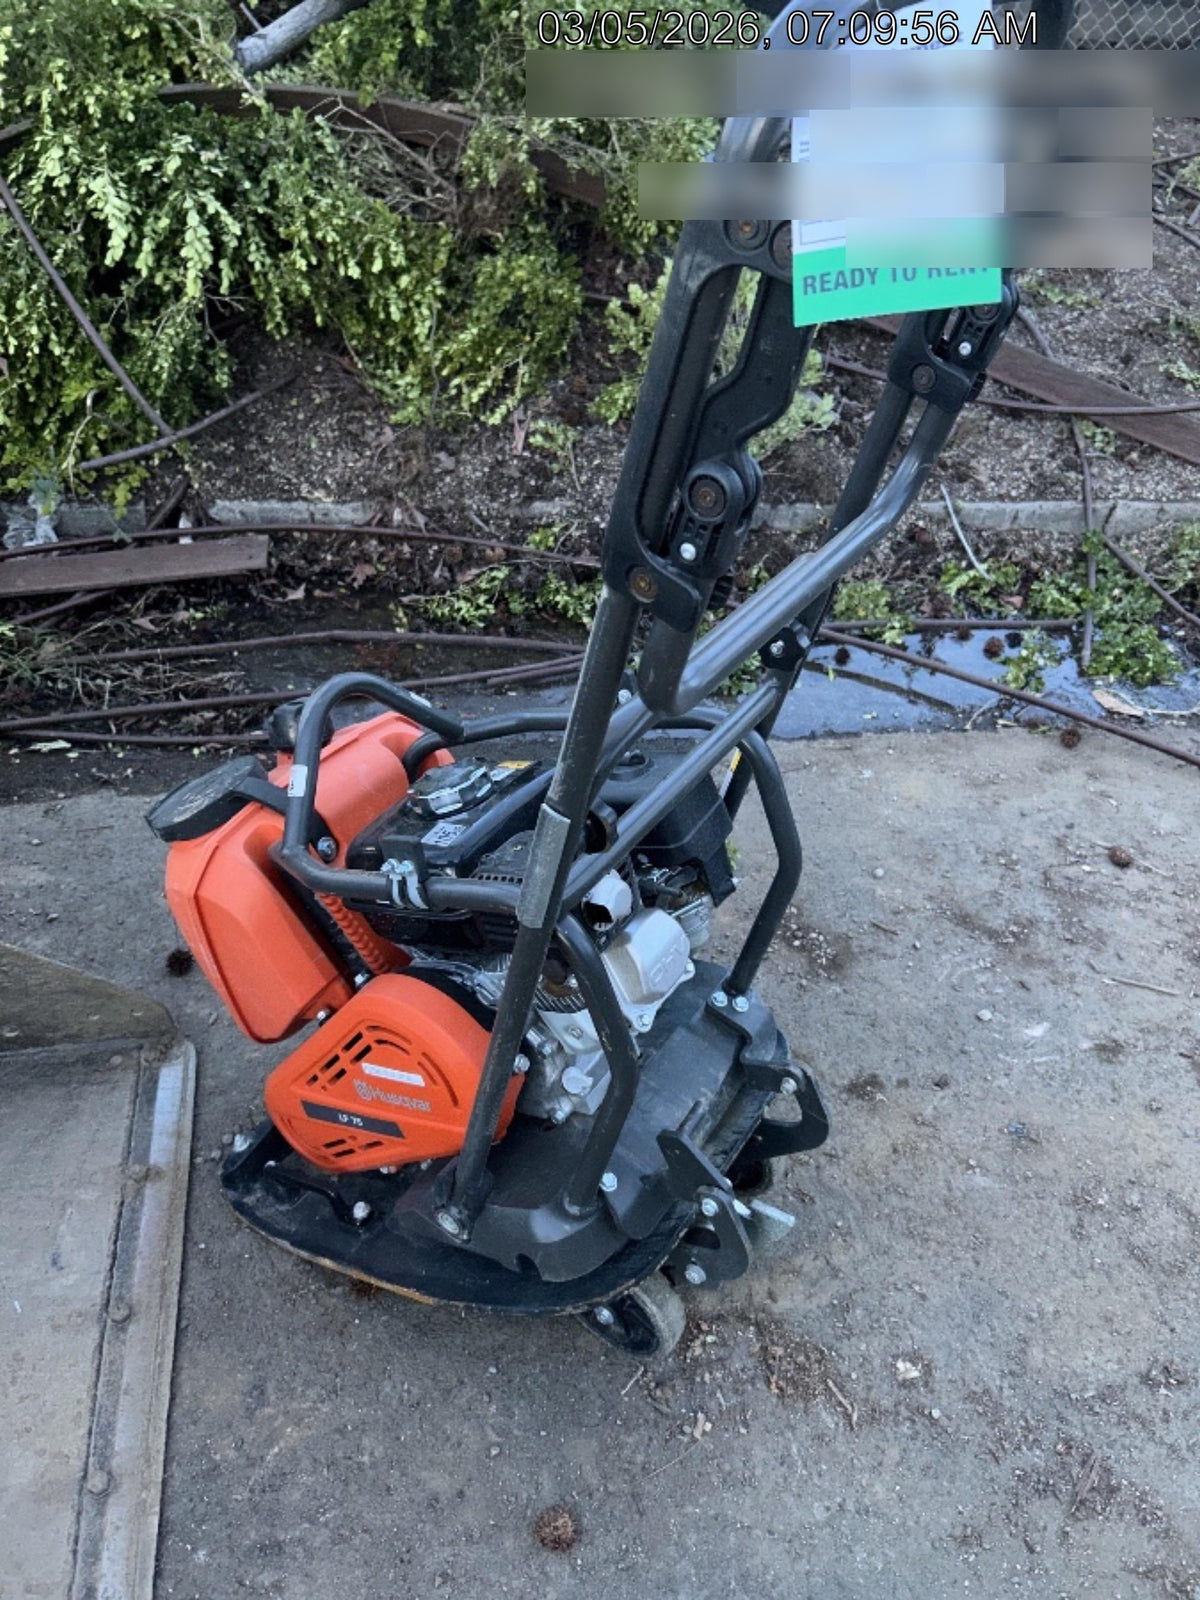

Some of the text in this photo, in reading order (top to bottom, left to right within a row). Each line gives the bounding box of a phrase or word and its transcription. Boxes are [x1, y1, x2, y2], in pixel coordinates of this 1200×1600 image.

[802, 267, 988, 296] READY TO RE
